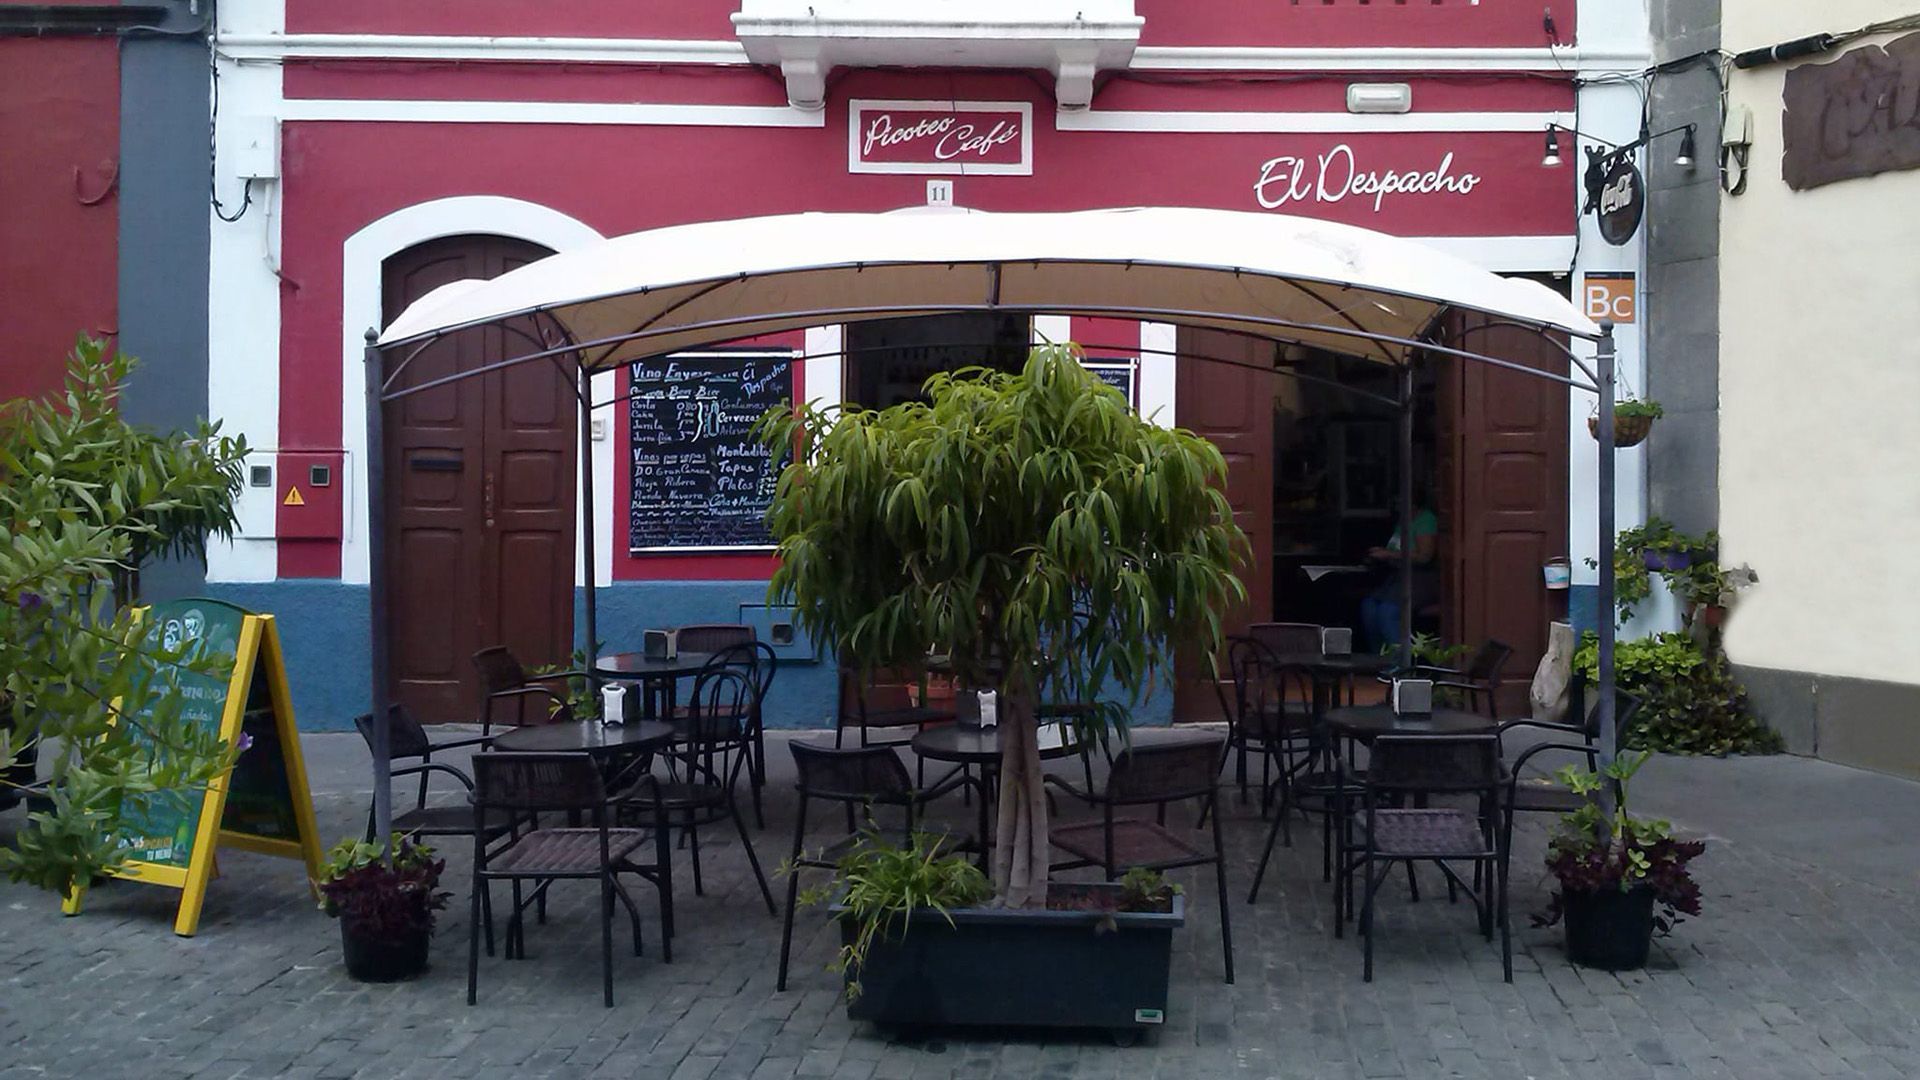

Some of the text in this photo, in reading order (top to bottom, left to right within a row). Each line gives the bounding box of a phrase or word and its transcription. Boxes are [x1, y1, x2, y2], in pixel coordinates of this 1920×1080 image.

[864, 115, 1019, 159] Picoteo Café
[1253, 144, 1481, 212] El Despacho
[931, 186, 946, 201] 11
[1586, 286, 1632, 318] Bc
[632, 363, 662, 379] Vino
[718, 411, 760, 424] Cervezas
[633, 448, 660, 462] Vinos
[680, 452, 706, 464] copas
[716, 441, 773, 457] Montaditos
[718, 460, 754, 476] Tapas
[635, 477, 696, 492] Rioja Ribera
[718, 478, 753, 492] Platos
[668, 490, 703, 501] Navarra
